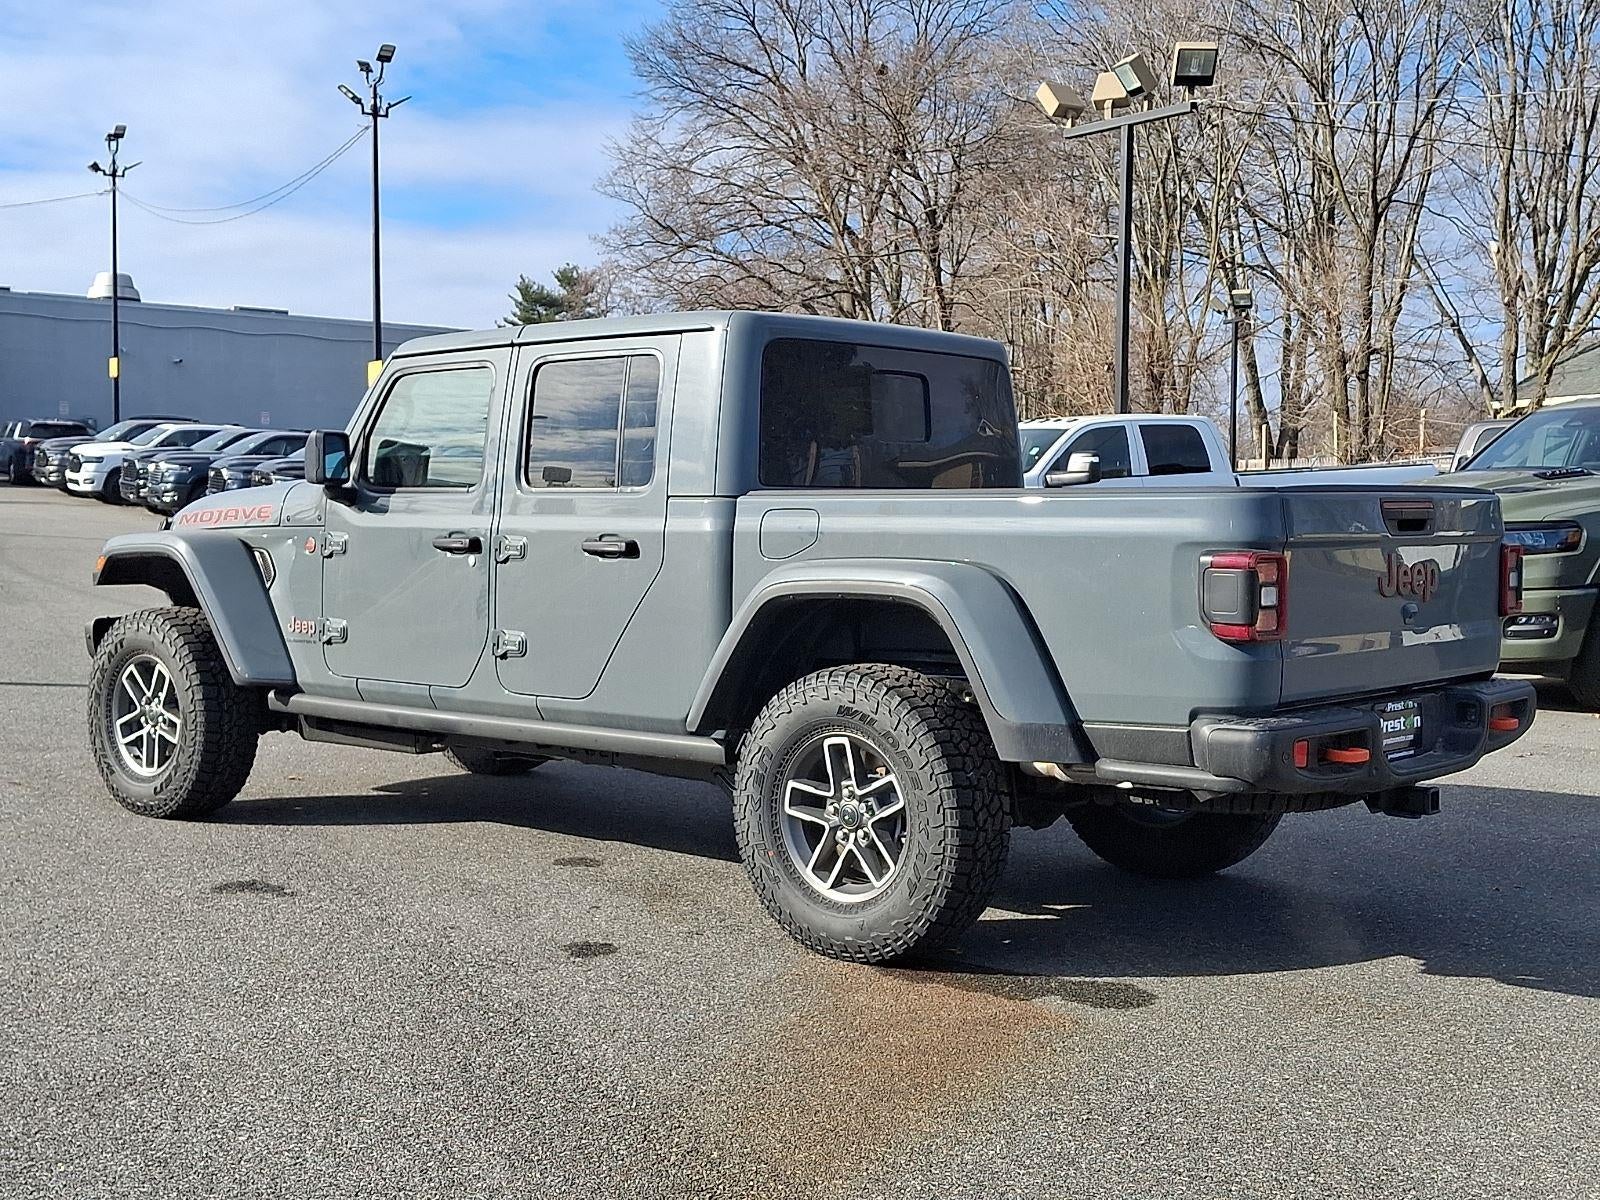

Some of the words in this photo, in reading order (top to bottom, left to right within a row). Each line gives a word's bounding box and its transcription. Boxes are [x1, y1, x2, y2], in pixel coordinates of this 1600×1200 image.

[179, 504, 273, 526] MOJAVE
[1378, 552, 1441, 603] Jeep
[287, 615, 317, 637] Jeep
